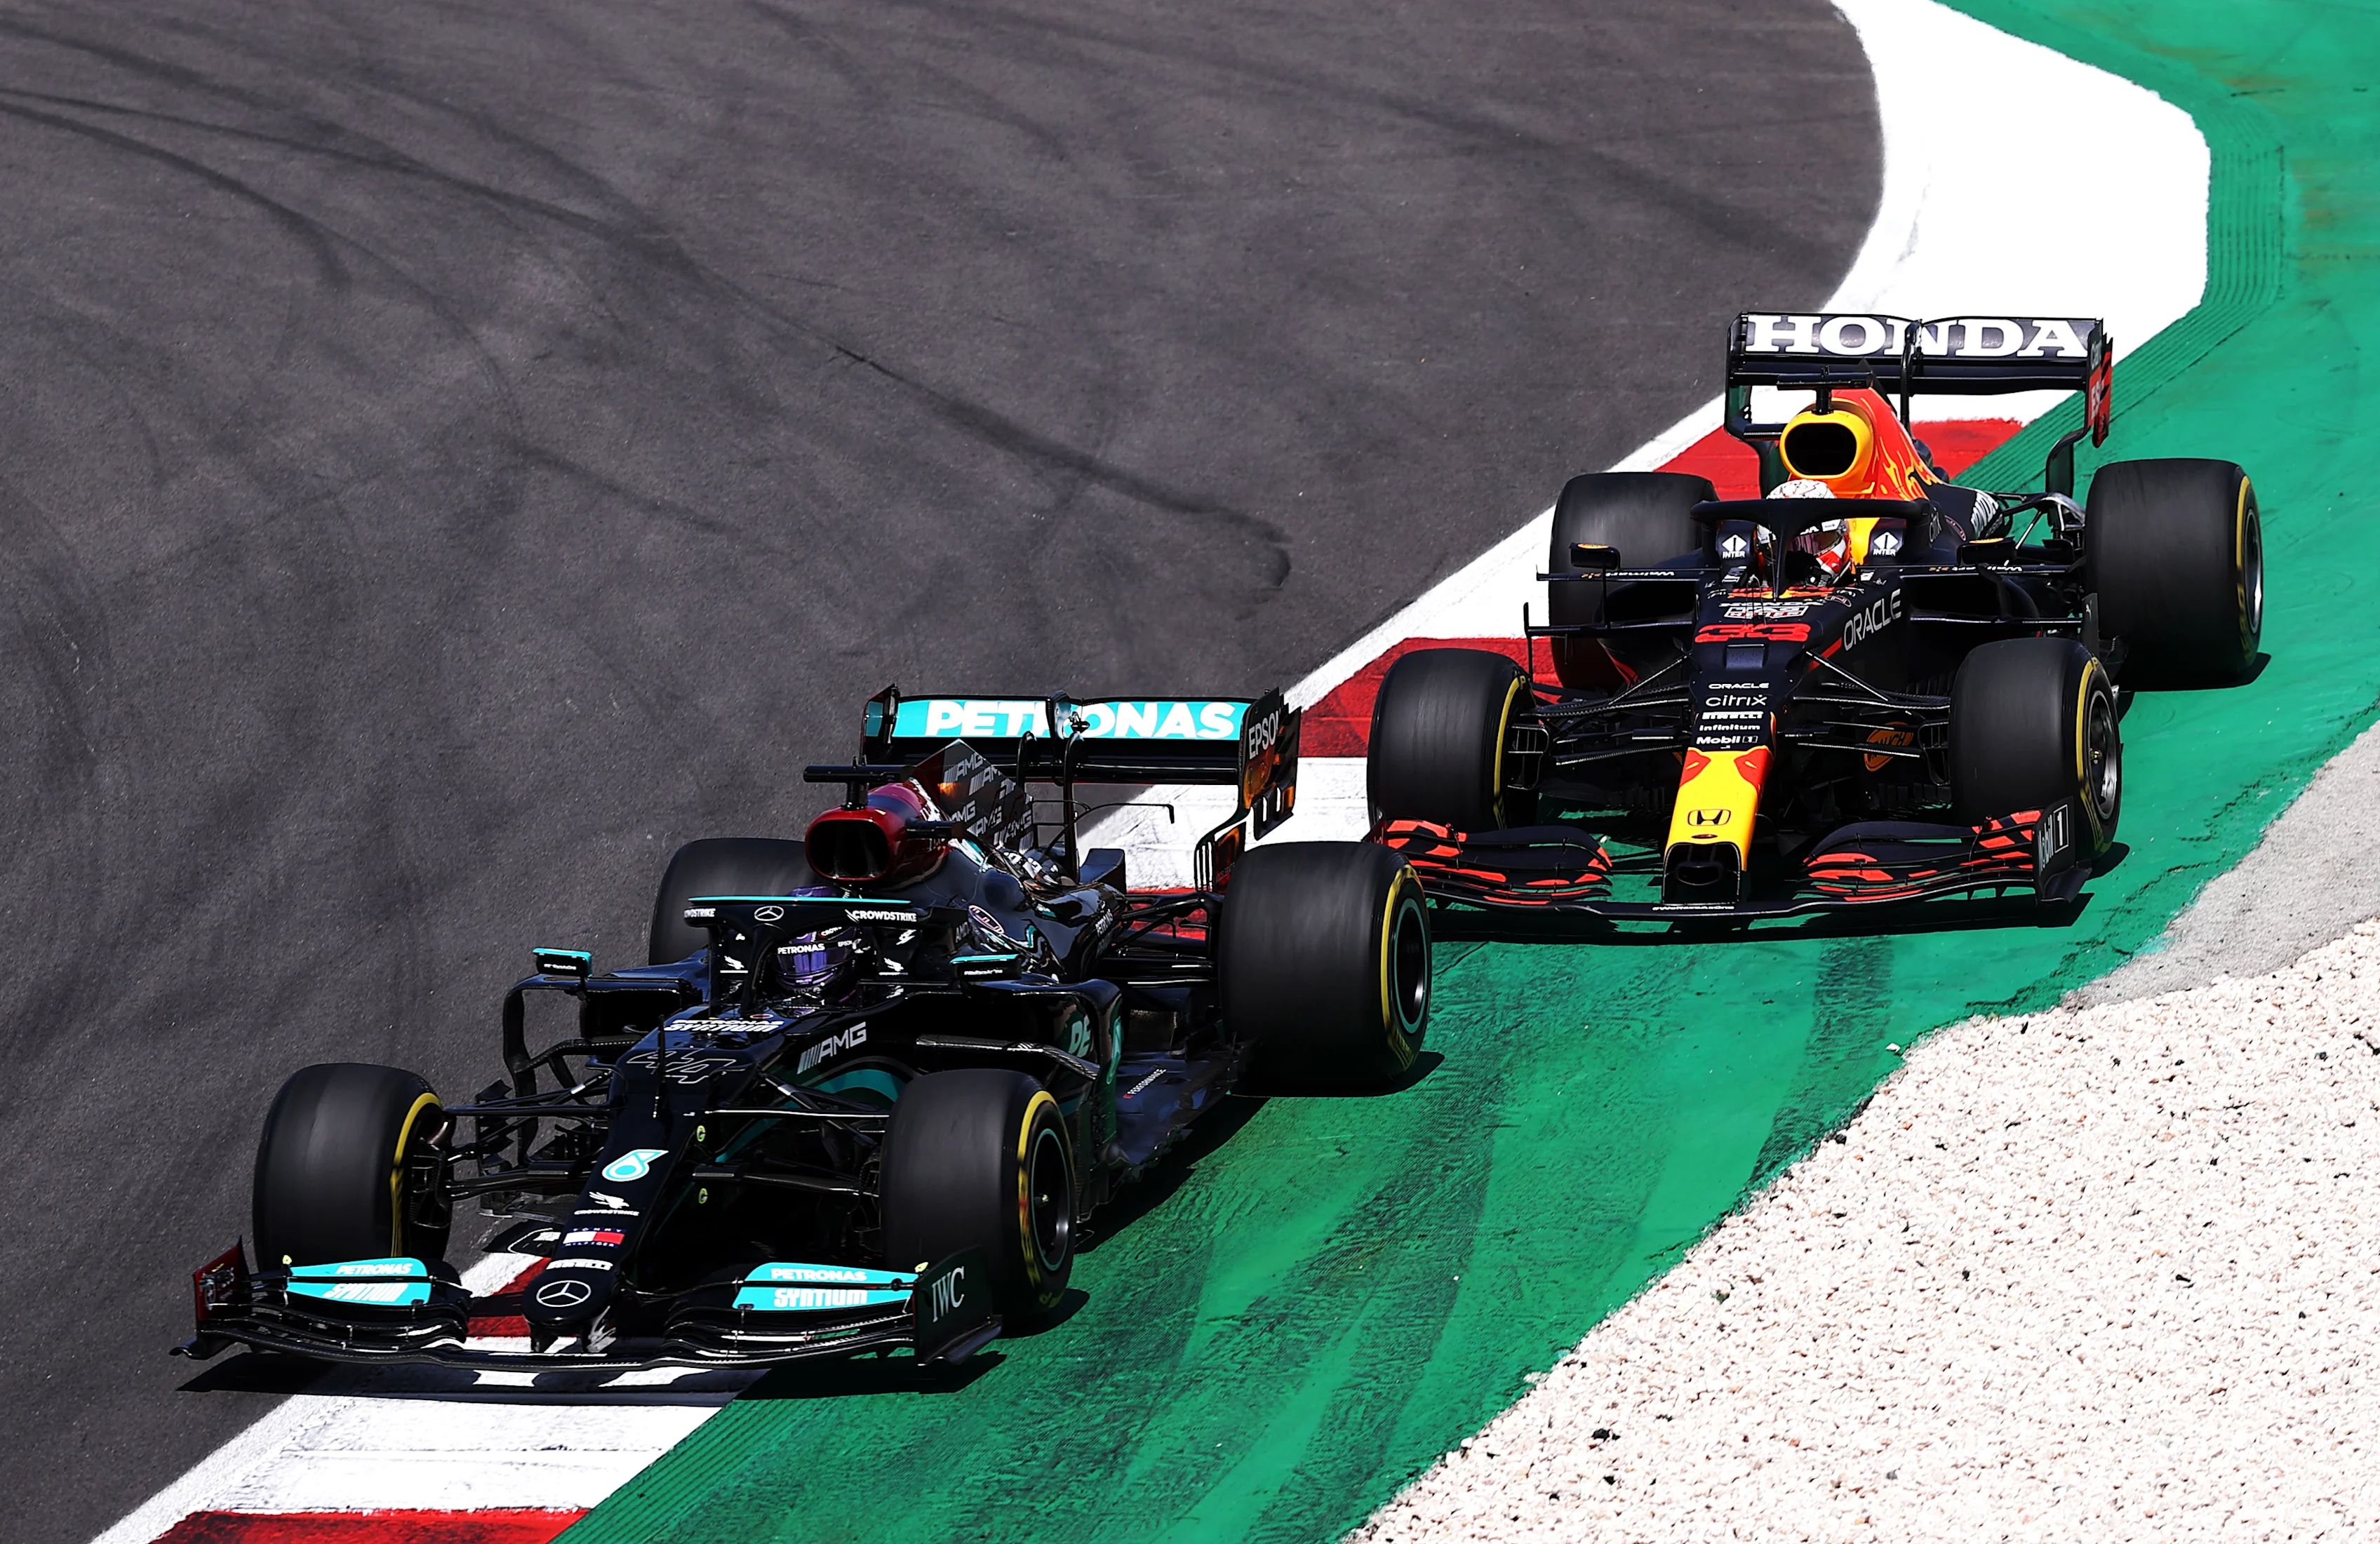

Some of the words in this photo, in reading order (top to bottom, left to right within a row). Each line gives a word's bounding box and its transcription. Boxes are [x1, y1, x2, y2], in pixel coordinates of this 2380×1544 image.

[1746, 316, 2089, 356] HONDA
[1873, 548, 1896, 556] INTER
[1844, 588, 1901, 651] ORACLE
[1694, 623, 1812, 643] 33
[1702, 711, 1764, 720] PIRELLI
[1696, 736, 1741, 744] Mobil
[852, 910, 917, 922] CROWDSTRIKE
[777, 943, 825, 955] PETRONAS
[817, 1021, 867, 1063] AMG
[335, 1263, 413, 1275] PETRONAS
[546, 1258, 613, 1270] PIRELLI
[771, 1268, 867, 1281] PETRONAS
[774, 1288, 869, 1308] SYNTIUM
[931, 1266, 965, 1322] IWC
